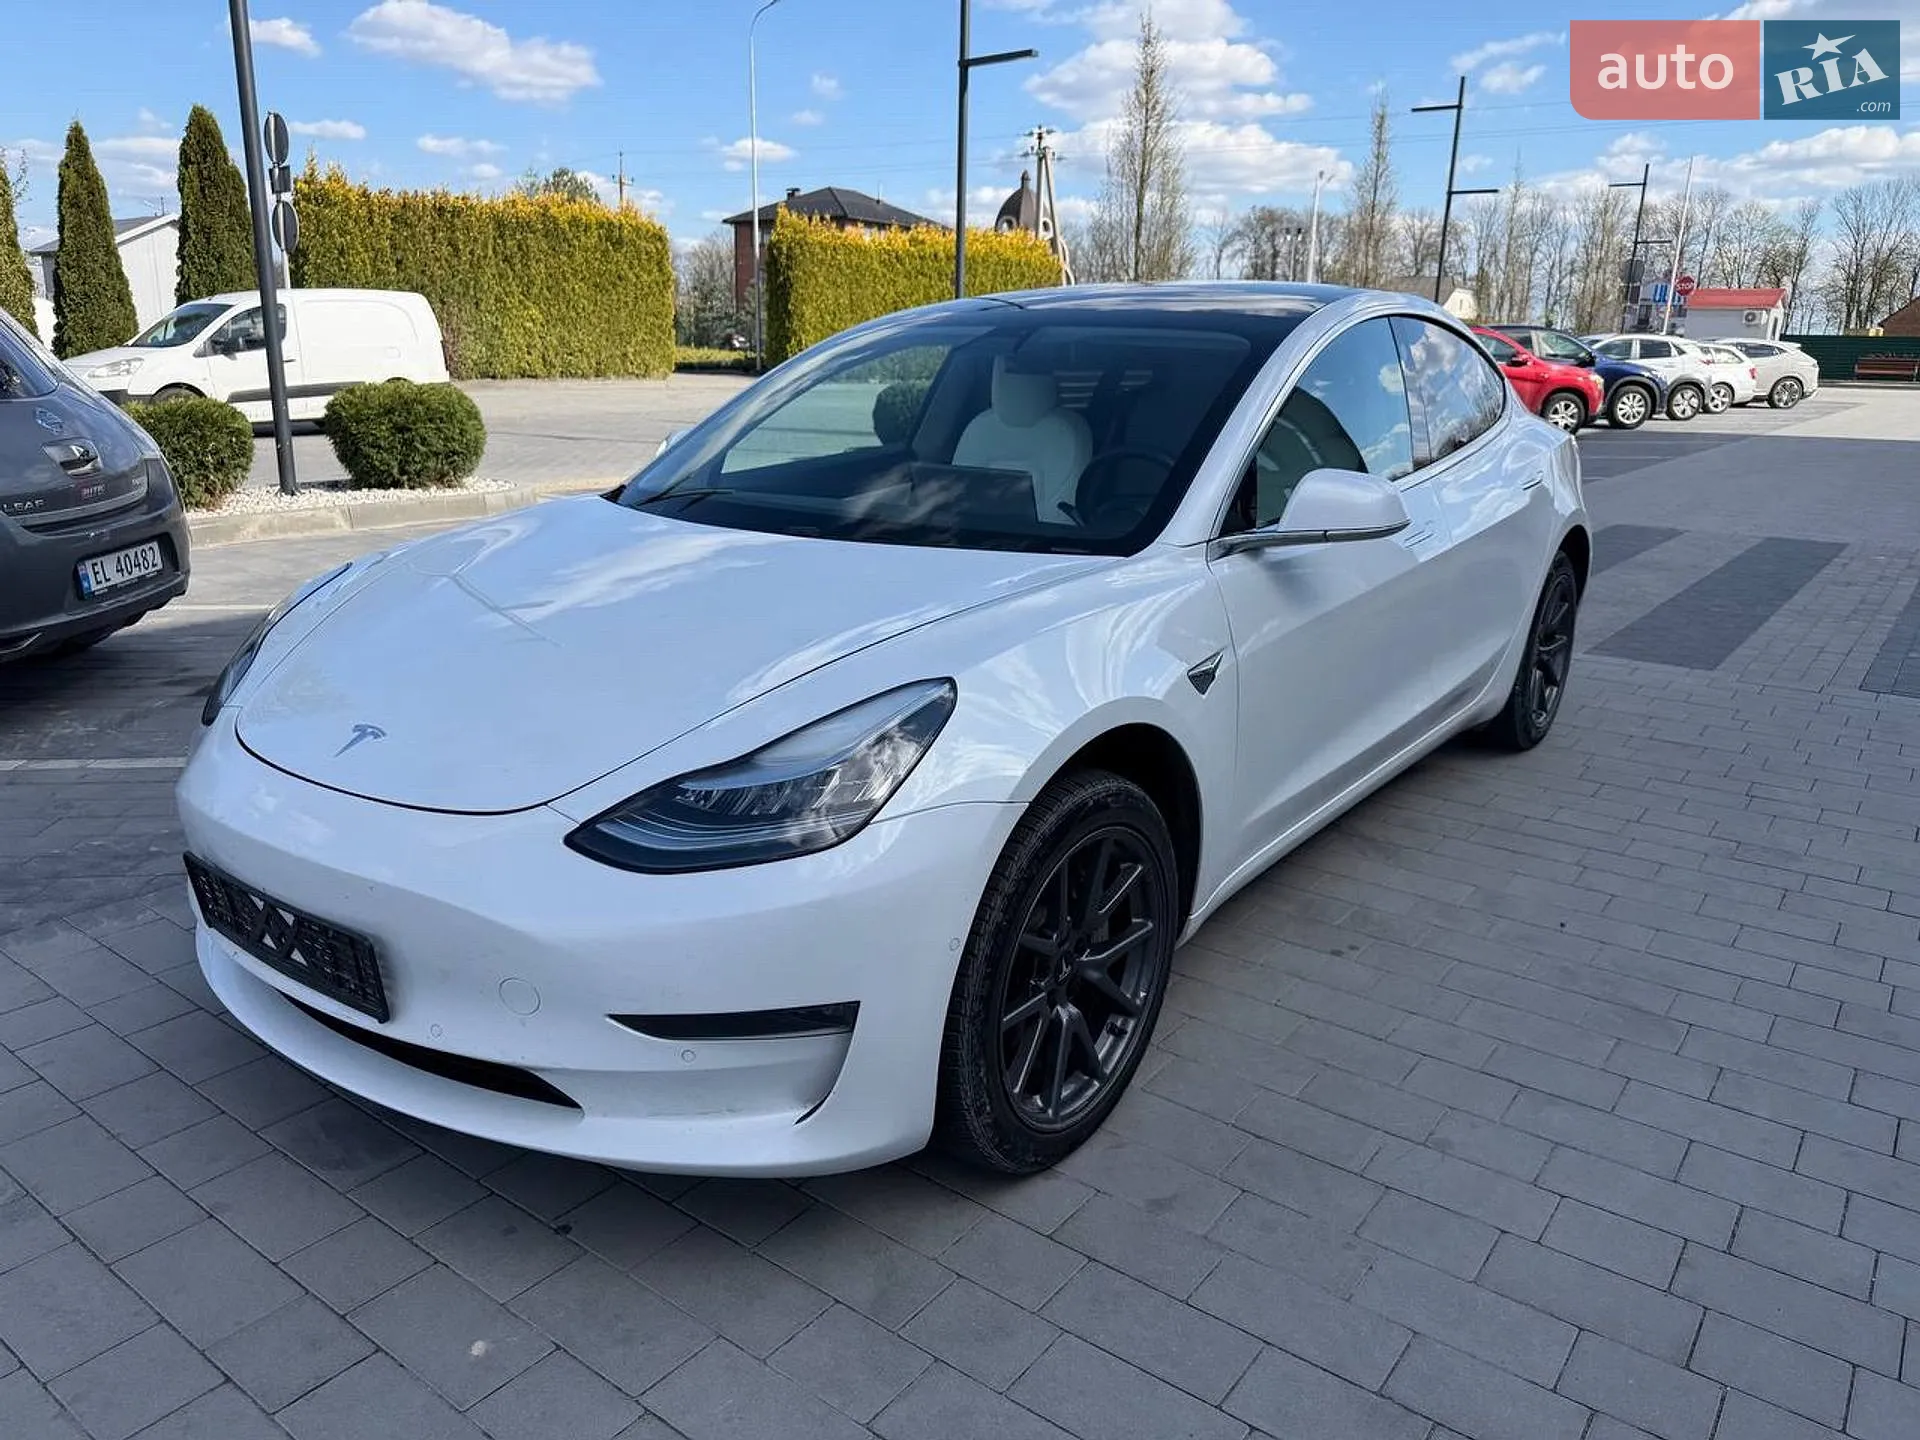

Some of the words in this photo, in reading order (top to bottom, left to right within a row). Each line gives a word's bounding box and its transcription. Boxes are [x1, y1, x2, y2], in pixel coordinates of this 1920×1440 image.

[1676, 282, 1694, 290] STOP
[3, 499, 44, 512] LEAF
[91, 560, 111, 585] EL
[116, 546, 157, 577] 40482
